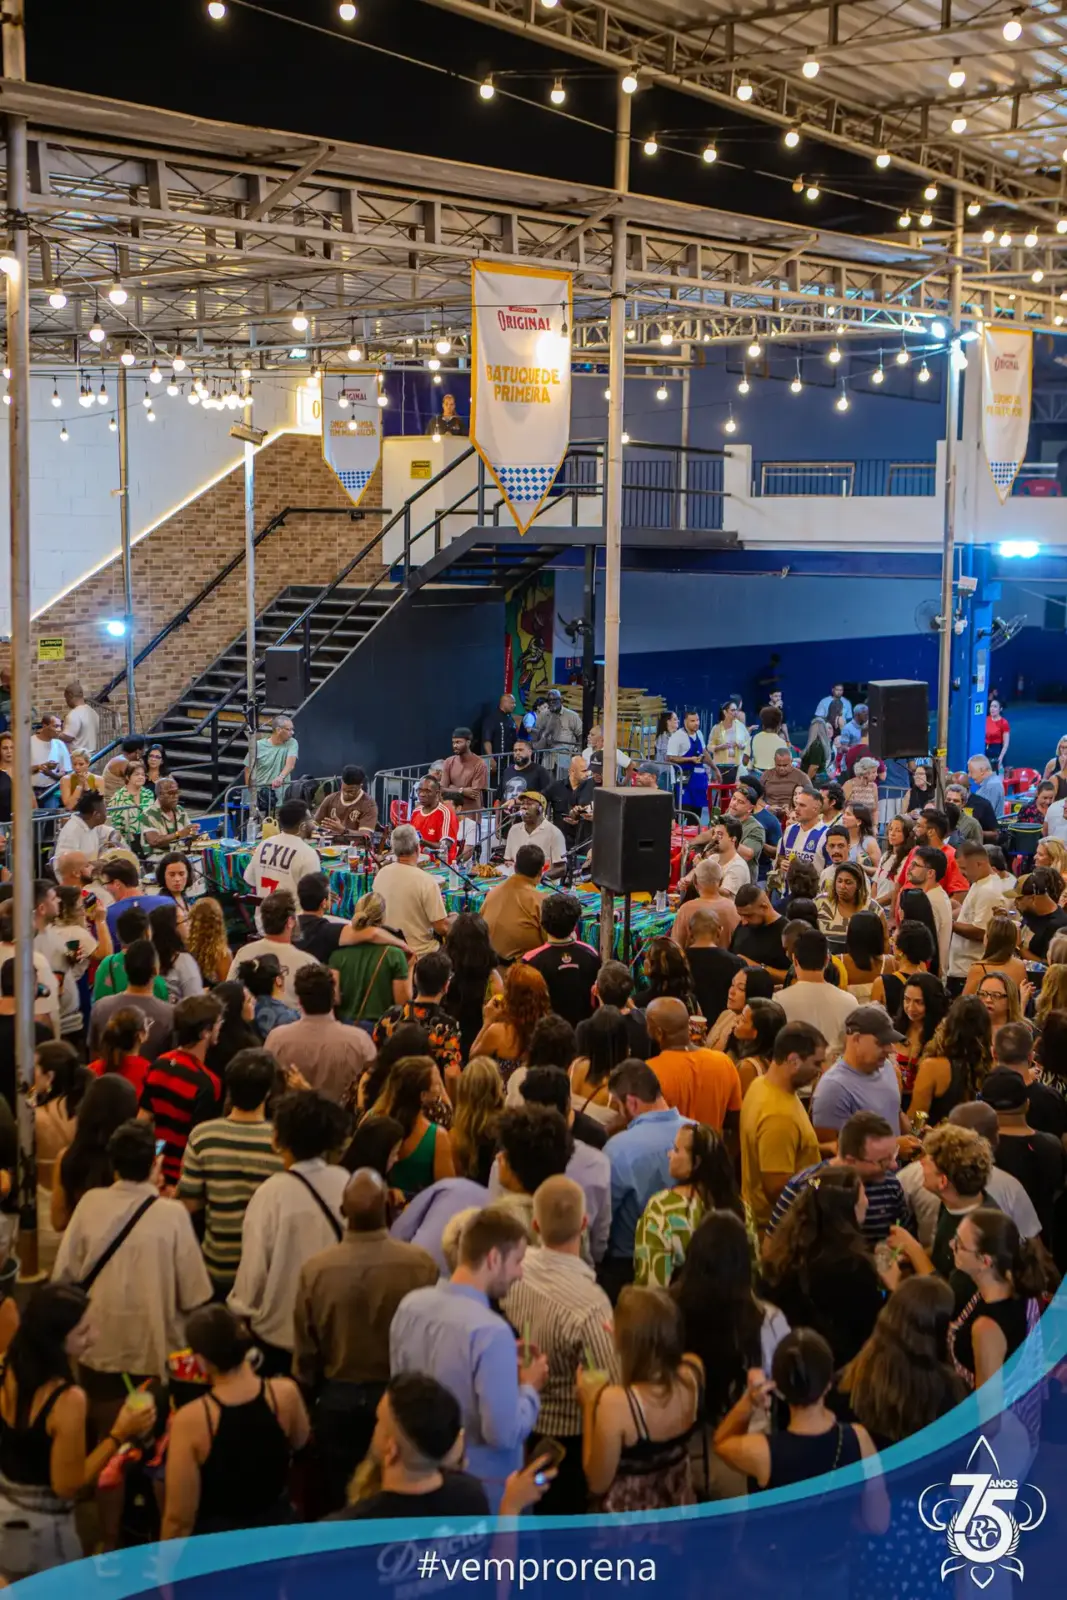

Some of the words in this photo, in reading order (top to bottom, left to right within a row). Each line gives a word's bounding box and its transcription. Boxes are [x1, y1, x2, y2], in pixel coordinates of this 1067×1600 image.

[498, 310, 551, 331] ORIGINAL
[486, 365, 540, 384] BATUQUE
[541, 368, 560, 385] DE
[493, 384, 551, 403] PRIMEIRA
[260, 842, 297, 870] EXU
